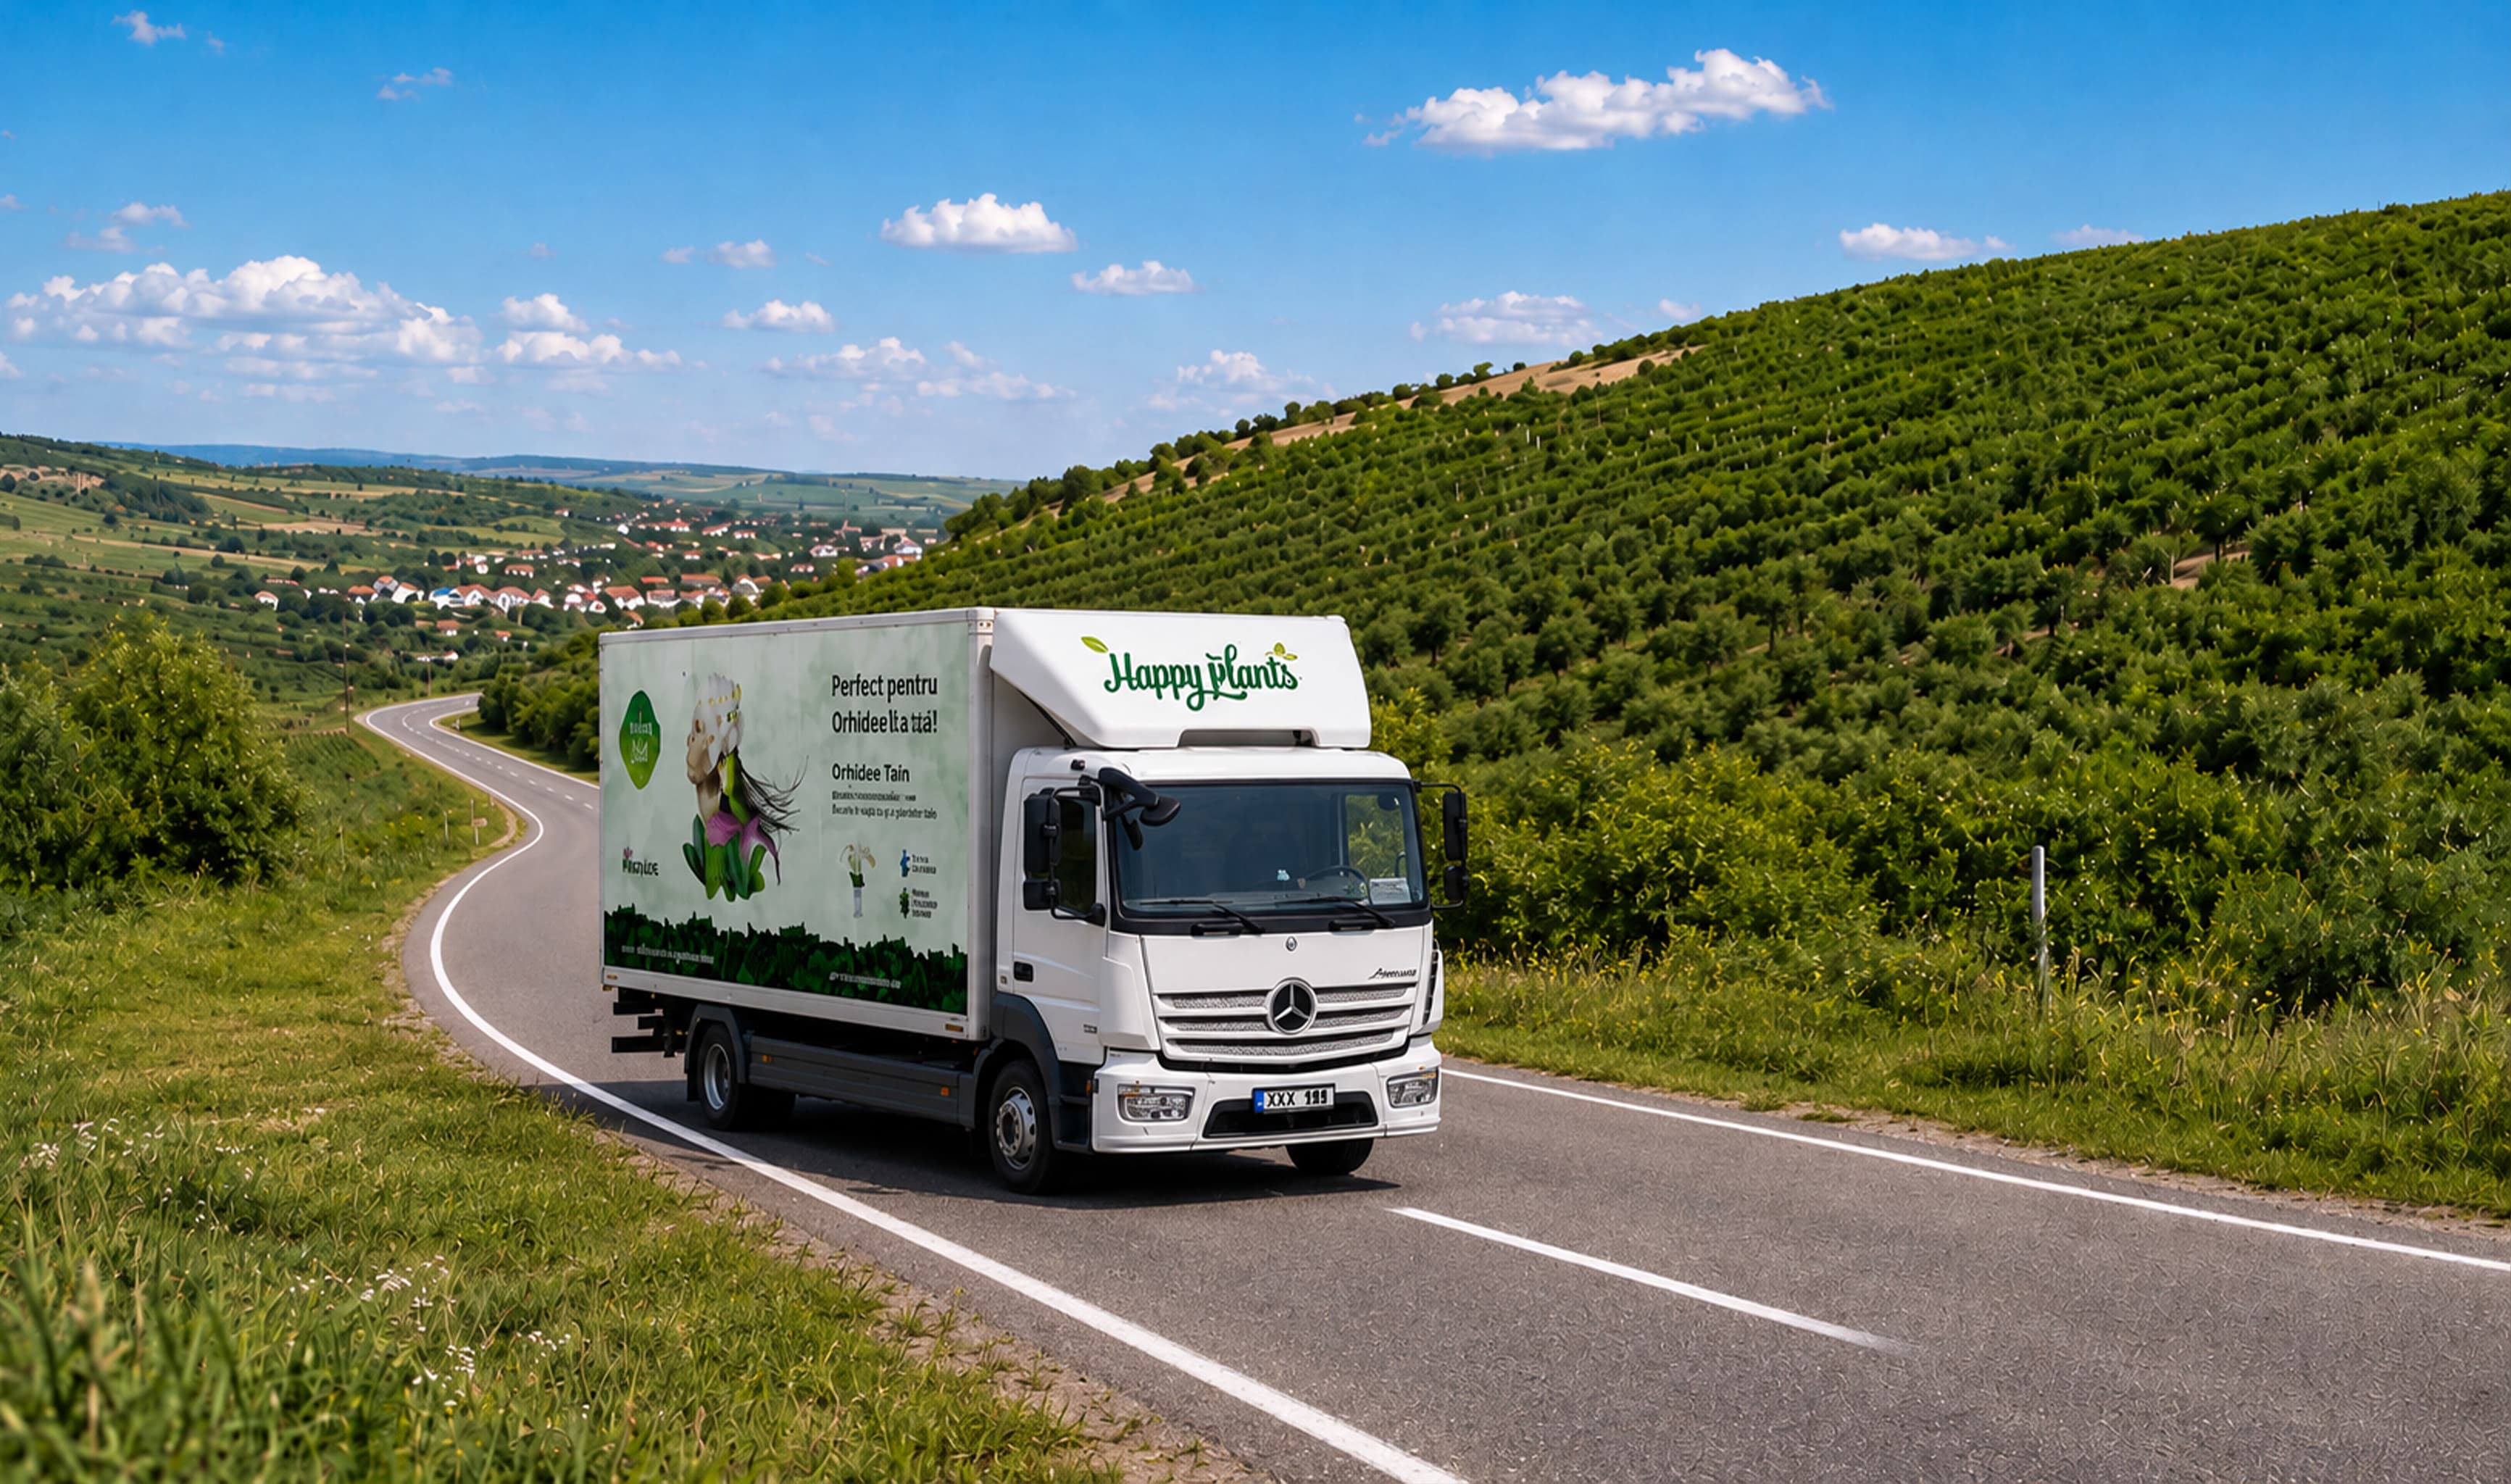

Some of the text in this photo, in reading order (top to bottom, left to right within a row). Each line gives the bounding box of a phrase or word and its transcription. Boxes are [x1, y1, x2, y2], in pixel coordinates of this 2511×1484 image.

[832, 673, 938, 704] Perfect pentru
[1104, 652, 1205, 711] Happy
[832, 763, 910, 783] Orhidee Tain
[1267, 1092, 1295, 1107] XXX
